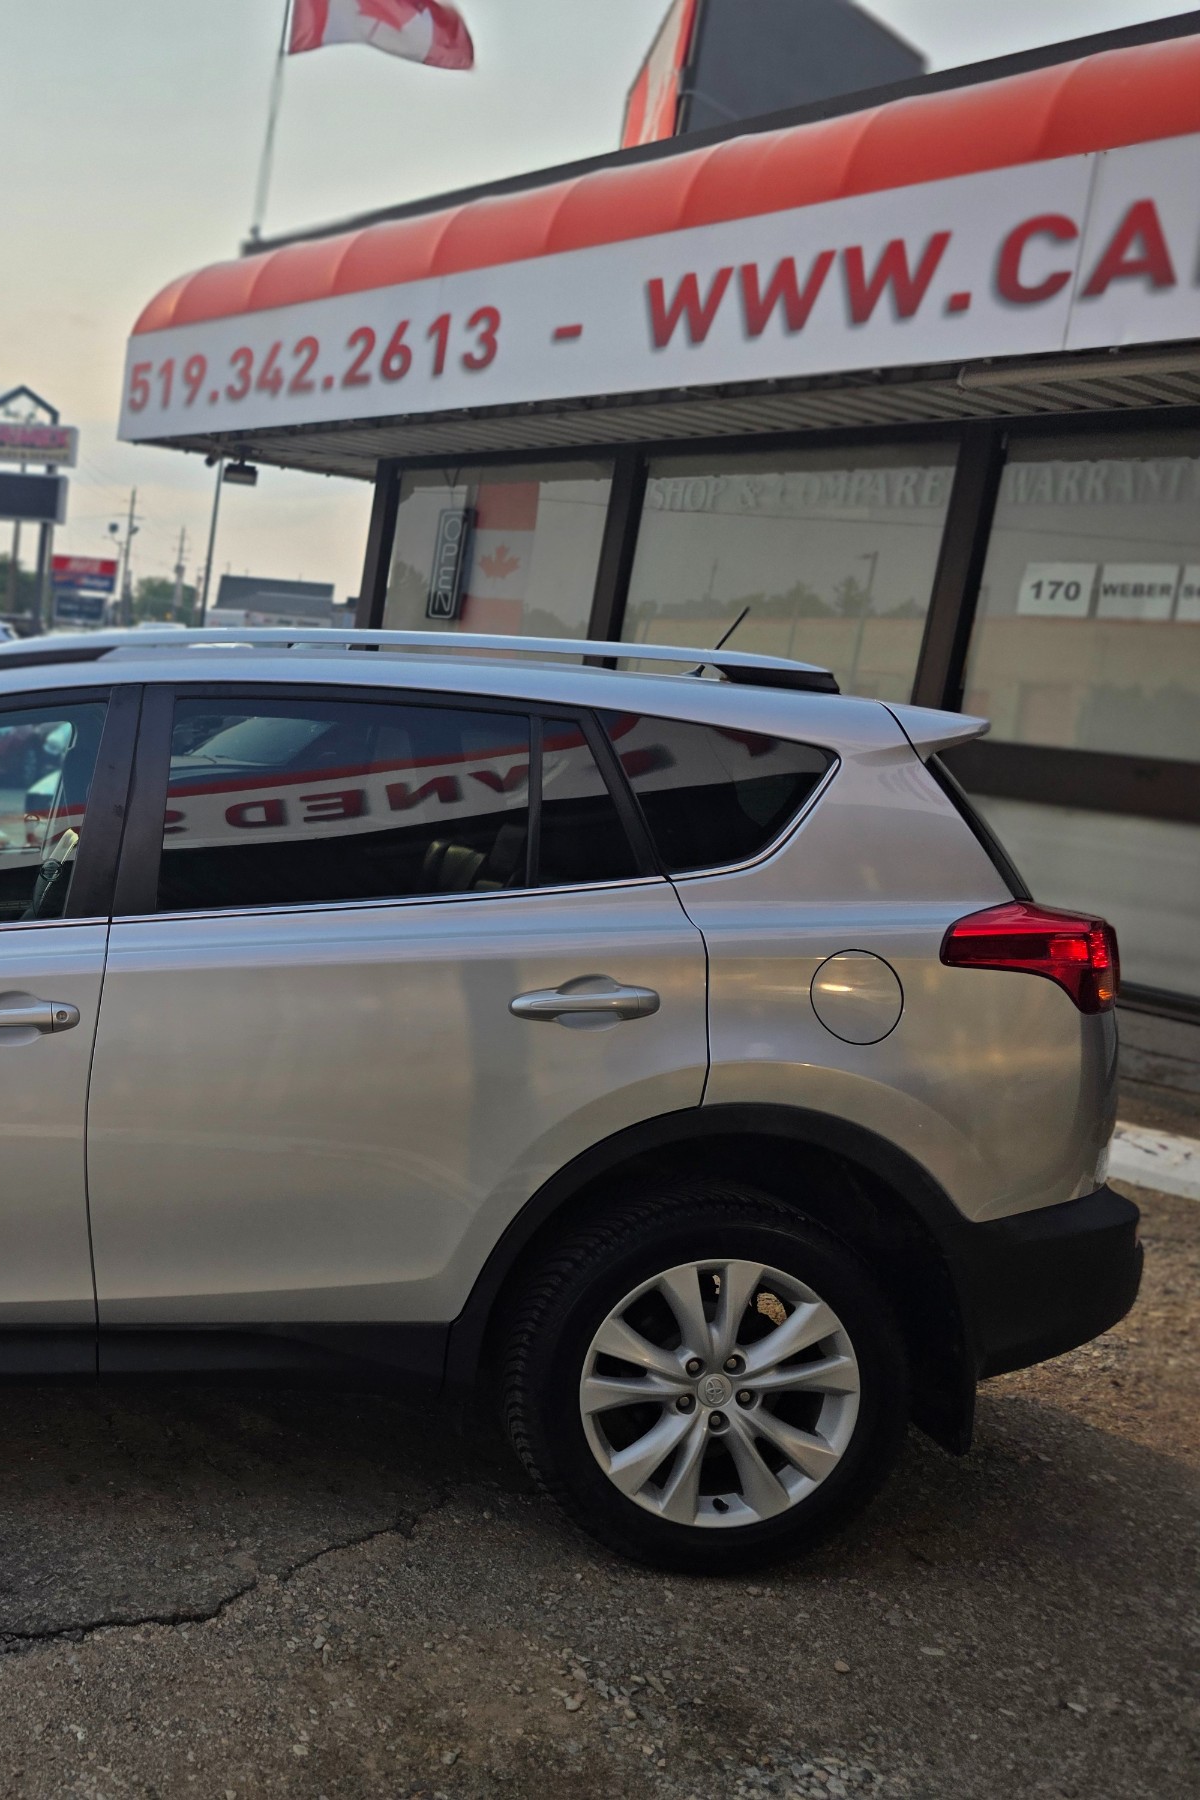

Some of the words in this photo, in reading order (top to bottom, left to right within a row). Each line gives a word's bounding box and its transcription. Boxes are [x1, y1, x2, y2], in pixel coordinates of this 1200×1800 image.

[128, 305, 501, 412] 519.342.2613
[648, 197, 1178, 348] WWW.CA
[650, 477, 726, 511] SHOP
[741, 481, 761, 508] &
[777, 470, 946, 508] COMPARE
[1005, 462, 1200, 502] WARRANT
[433, 517, 462, 613] OPEN
[1029, 580, 1082, 602] 170
[1102, 583, 1173, 598] WEBER
